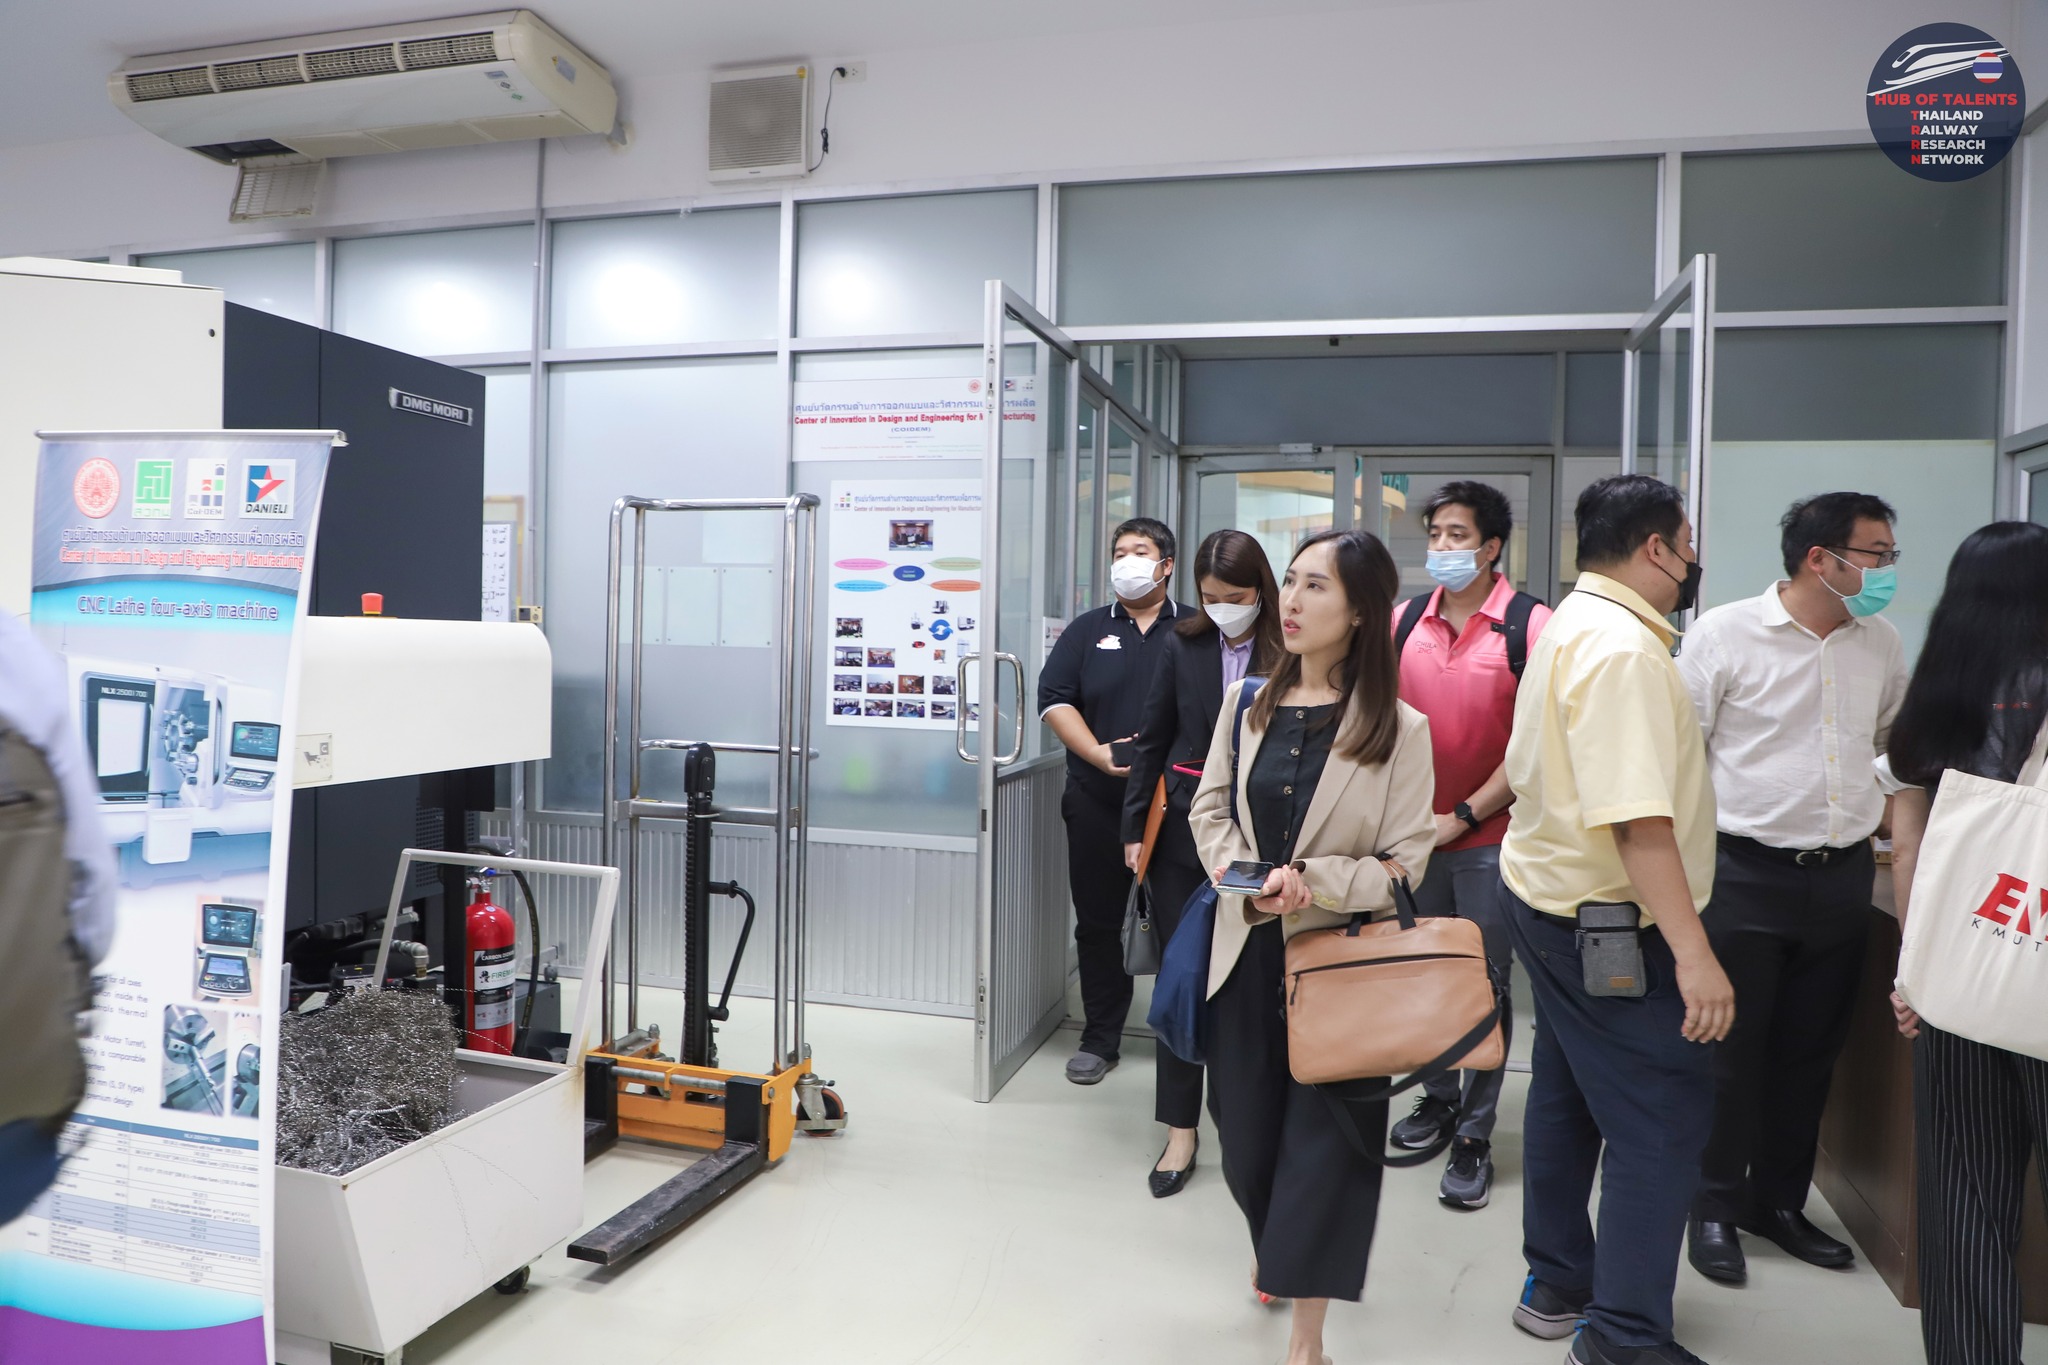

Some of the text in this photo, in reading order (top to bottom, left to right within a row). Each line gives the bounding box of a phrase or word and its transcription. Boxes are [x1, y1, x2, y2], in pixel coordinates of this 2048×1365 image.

[402, 395, 463, 420] DMG MORI
[795, 416, 818, 424] Center
[820, 416, 828, 424] of
[829, 416, 867, 424] Innovation
[869, 415, 876, 423] in
[878, 415, 903, 424] Design
[905, 414, 918, 422] and
[921, 413, 964, 423] Engineering
[967, 413, 977, 421] for
[245, 503, 288, 514] DANIELI
[60, 547, 304, 573] Center of Innovation in Design and Engineering for Manufacturing
[77, 595, 279, 620] CNC Lathe four-axis machine
